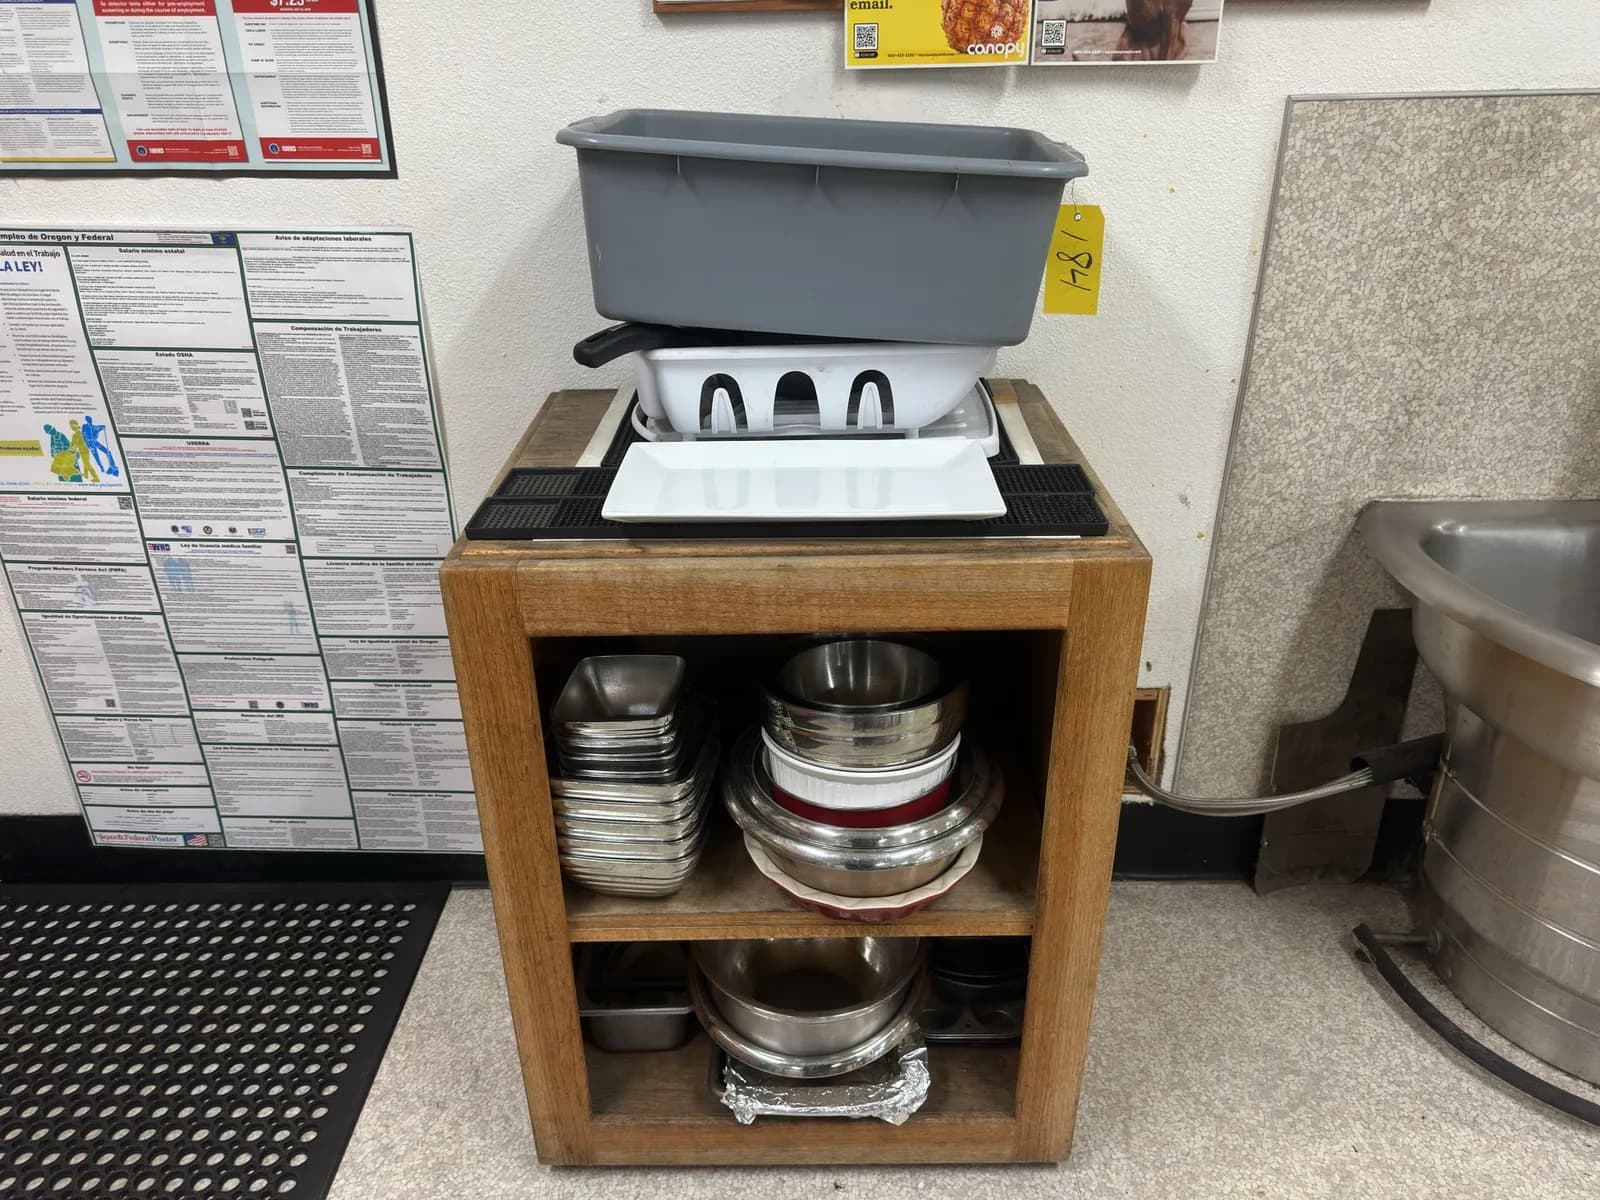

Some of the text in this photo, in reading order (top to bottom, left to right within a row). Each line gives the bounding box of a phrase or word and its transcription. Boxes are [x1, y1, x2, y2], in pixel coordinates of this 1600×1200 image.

[850, 0, 893, 10] email.
[967, 42, 1025, 58] canopy
[0, 233, 26, 242] mpleo
[41, 233, 72, 242] Oregon
[34, 250, 61, 259] Trabajo
[14, 260, 43, 272] LEY!
